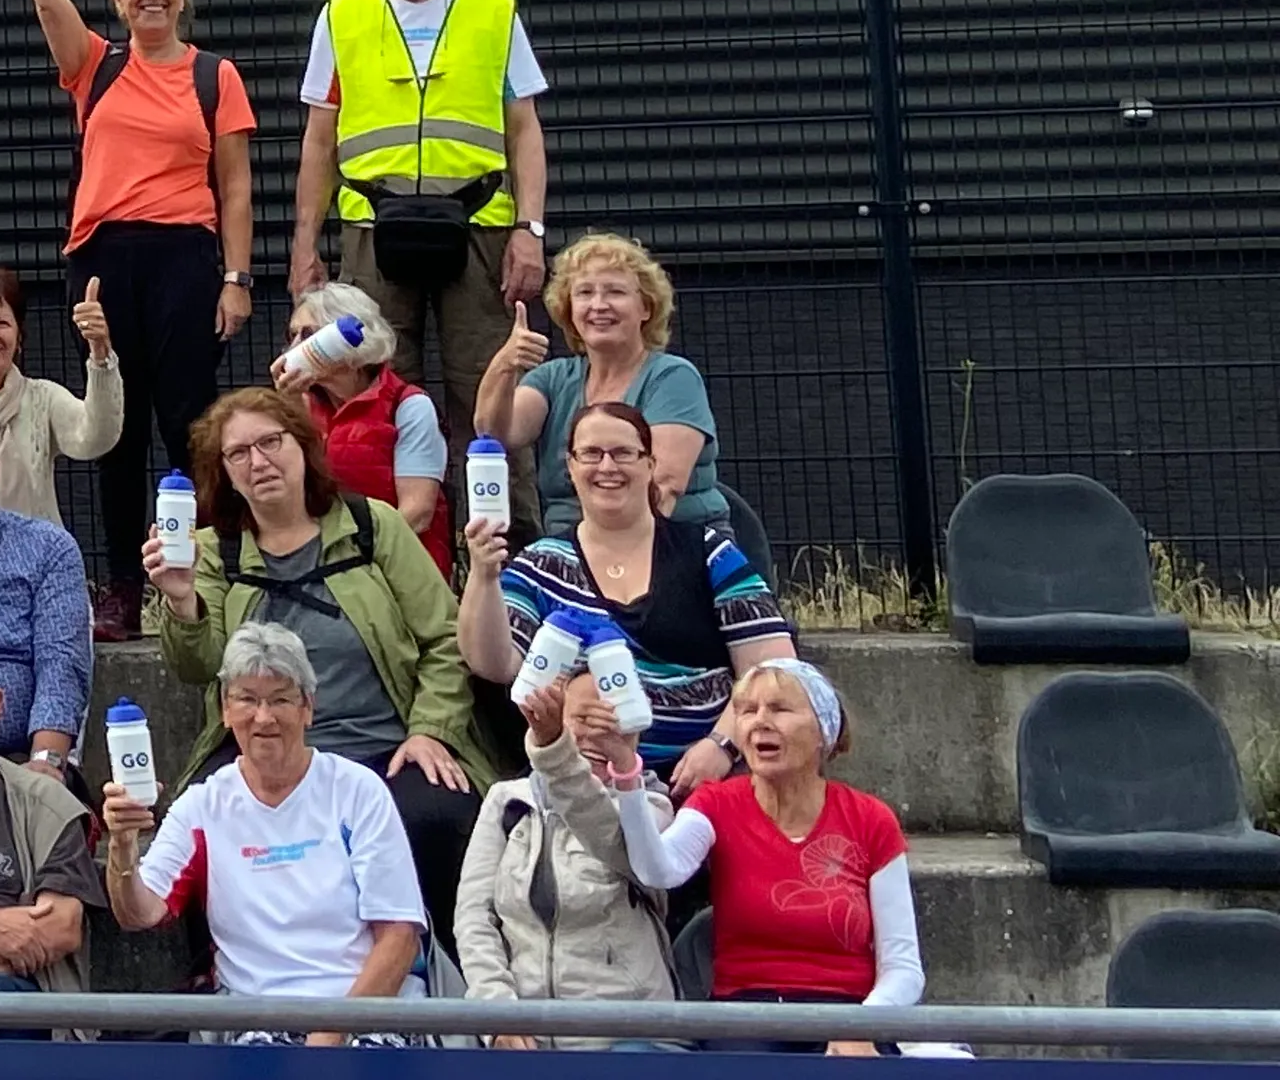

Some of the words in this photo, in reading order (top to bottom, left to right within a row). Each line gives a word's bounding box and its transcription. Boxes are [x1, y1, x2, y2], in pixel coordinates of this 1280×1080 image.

[473, 482, 501, 497] GO
[598, 672, 628, 691] GO
[120, 752, 149, 768] GO
